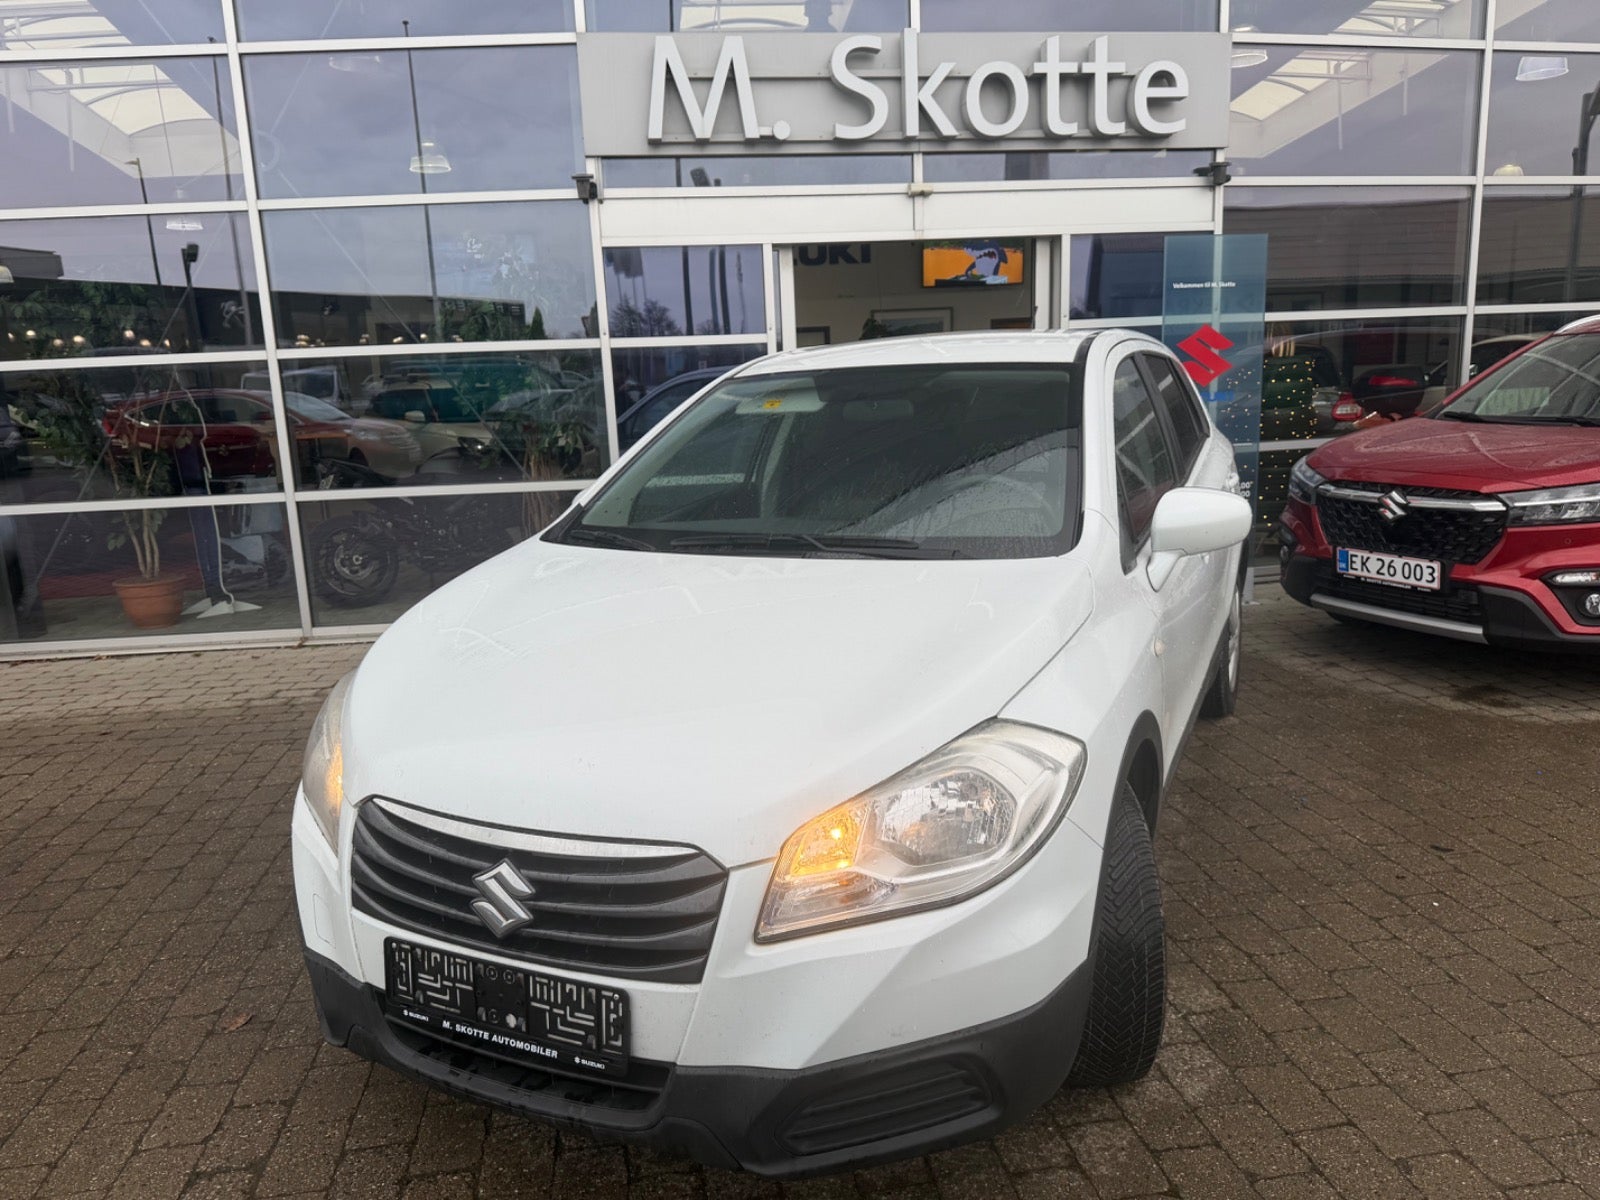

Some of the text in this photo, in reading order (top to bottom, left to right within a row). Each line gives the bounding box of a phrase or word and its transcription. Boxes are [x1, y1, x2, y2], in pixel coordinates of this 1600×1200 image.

[648, 28, 1189, 144] M. Skotte
[794, 244, 871, 266] UKI
[1349, 554, 1436, 584] EK 26 003
[442, 1020, 559, 1059] M. SKOTTE AUTOMOBILER
